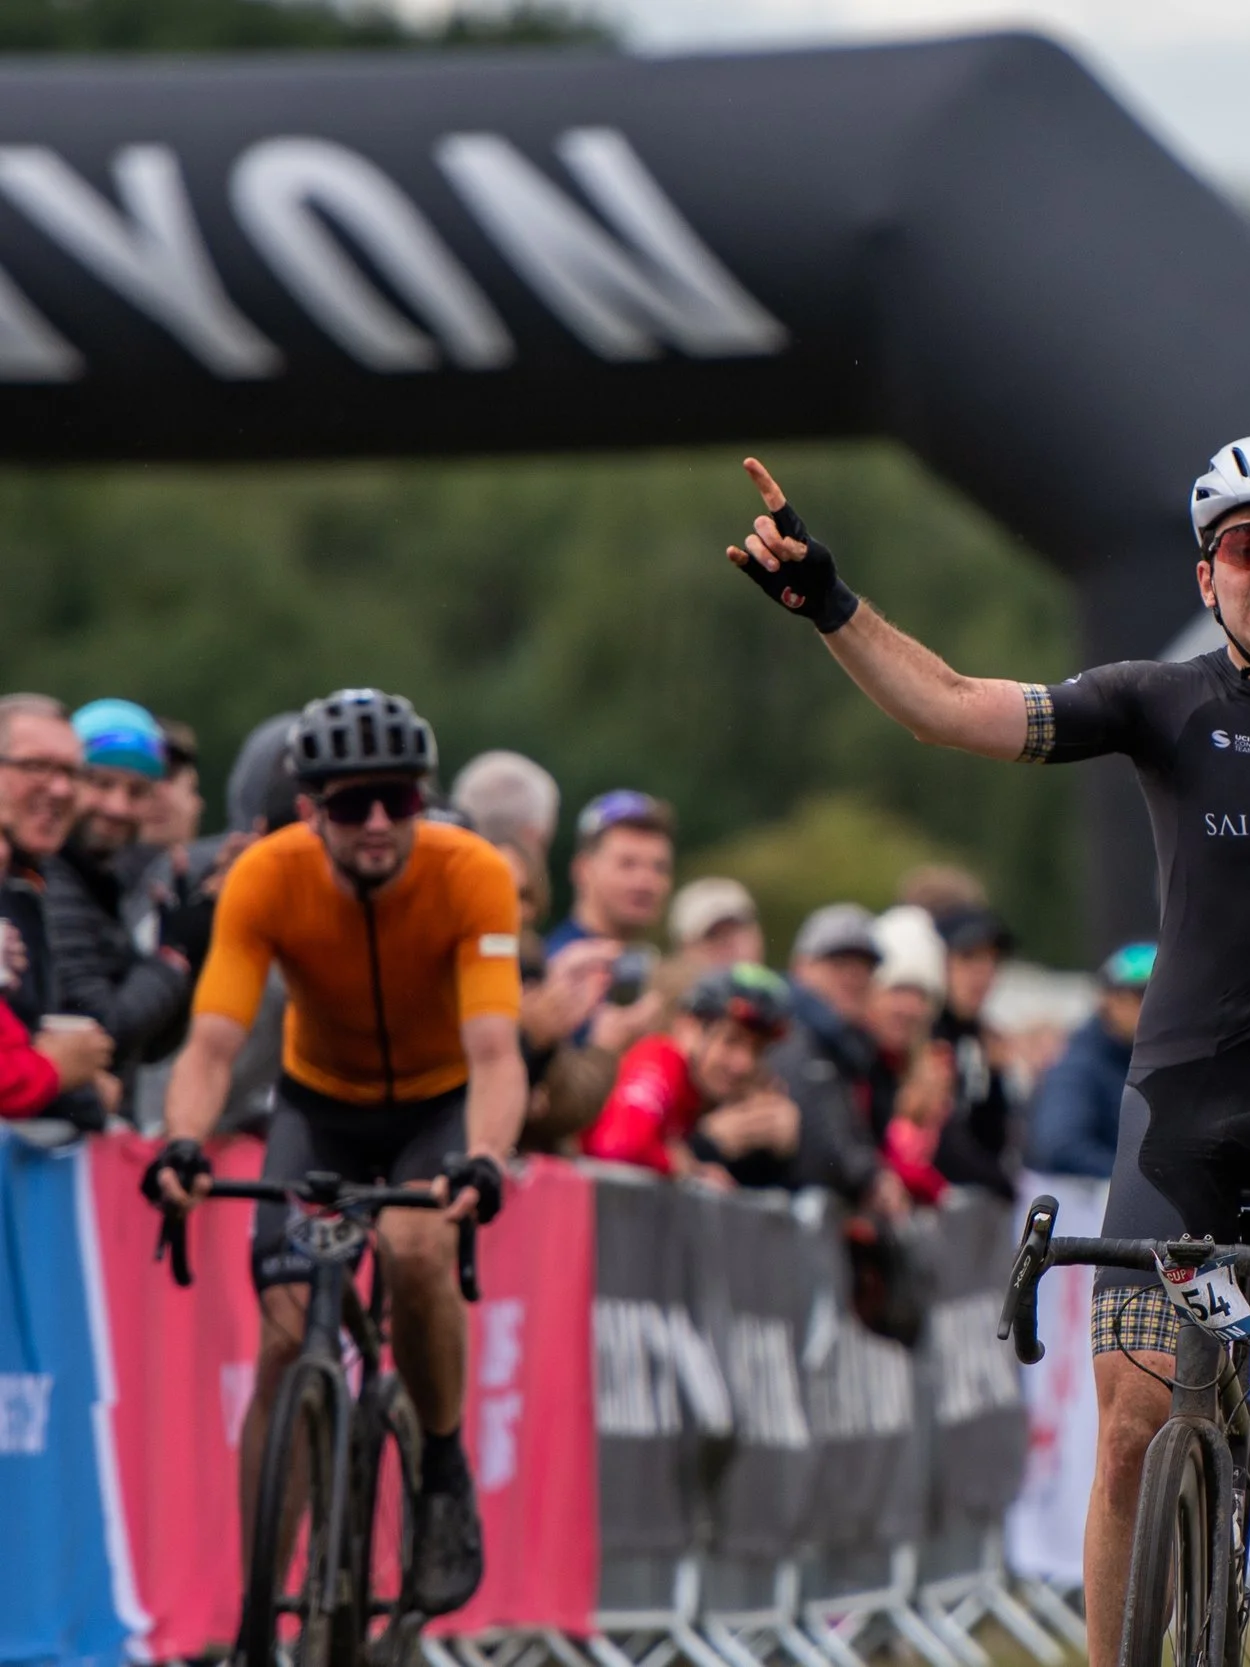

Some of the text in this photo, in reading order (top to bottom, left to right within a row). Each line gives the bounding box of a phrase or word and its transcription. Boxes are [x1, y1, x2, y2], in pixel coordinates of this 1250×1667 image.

[1234, 733, 1250, 742] UCI
[1013, 1255, 1031, 1289] GRX
[1166, 1269, 1186, 1282] CUP
[1181, 1281, 1231, 1322] 54
